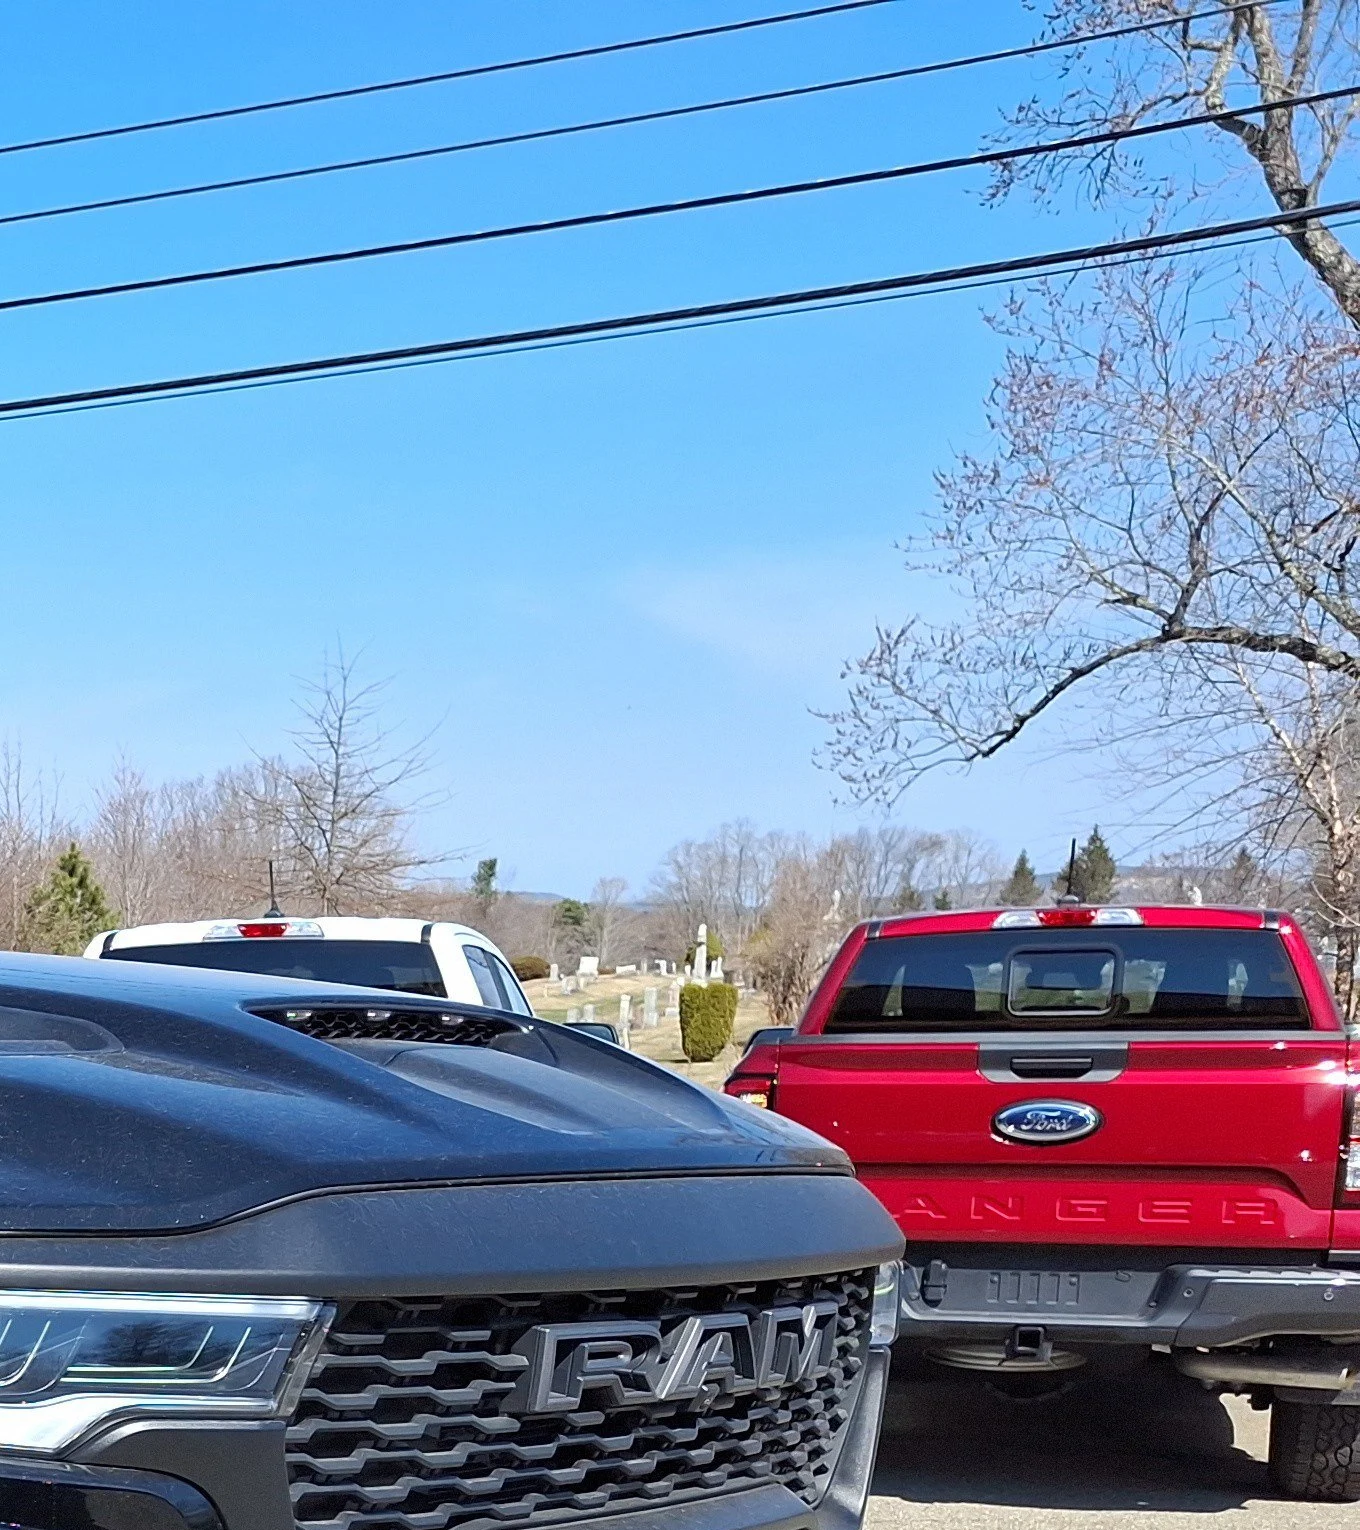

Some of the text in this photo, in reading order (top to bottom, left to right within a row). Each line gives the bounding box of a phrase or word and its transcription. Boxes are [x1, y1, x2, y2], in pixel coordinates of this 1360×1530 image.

[1021, 1110, 1073, 1131] Ford
[891, 1193, 1277, 1226] ANGER
[512, 1300, 840, 1413] RAM
